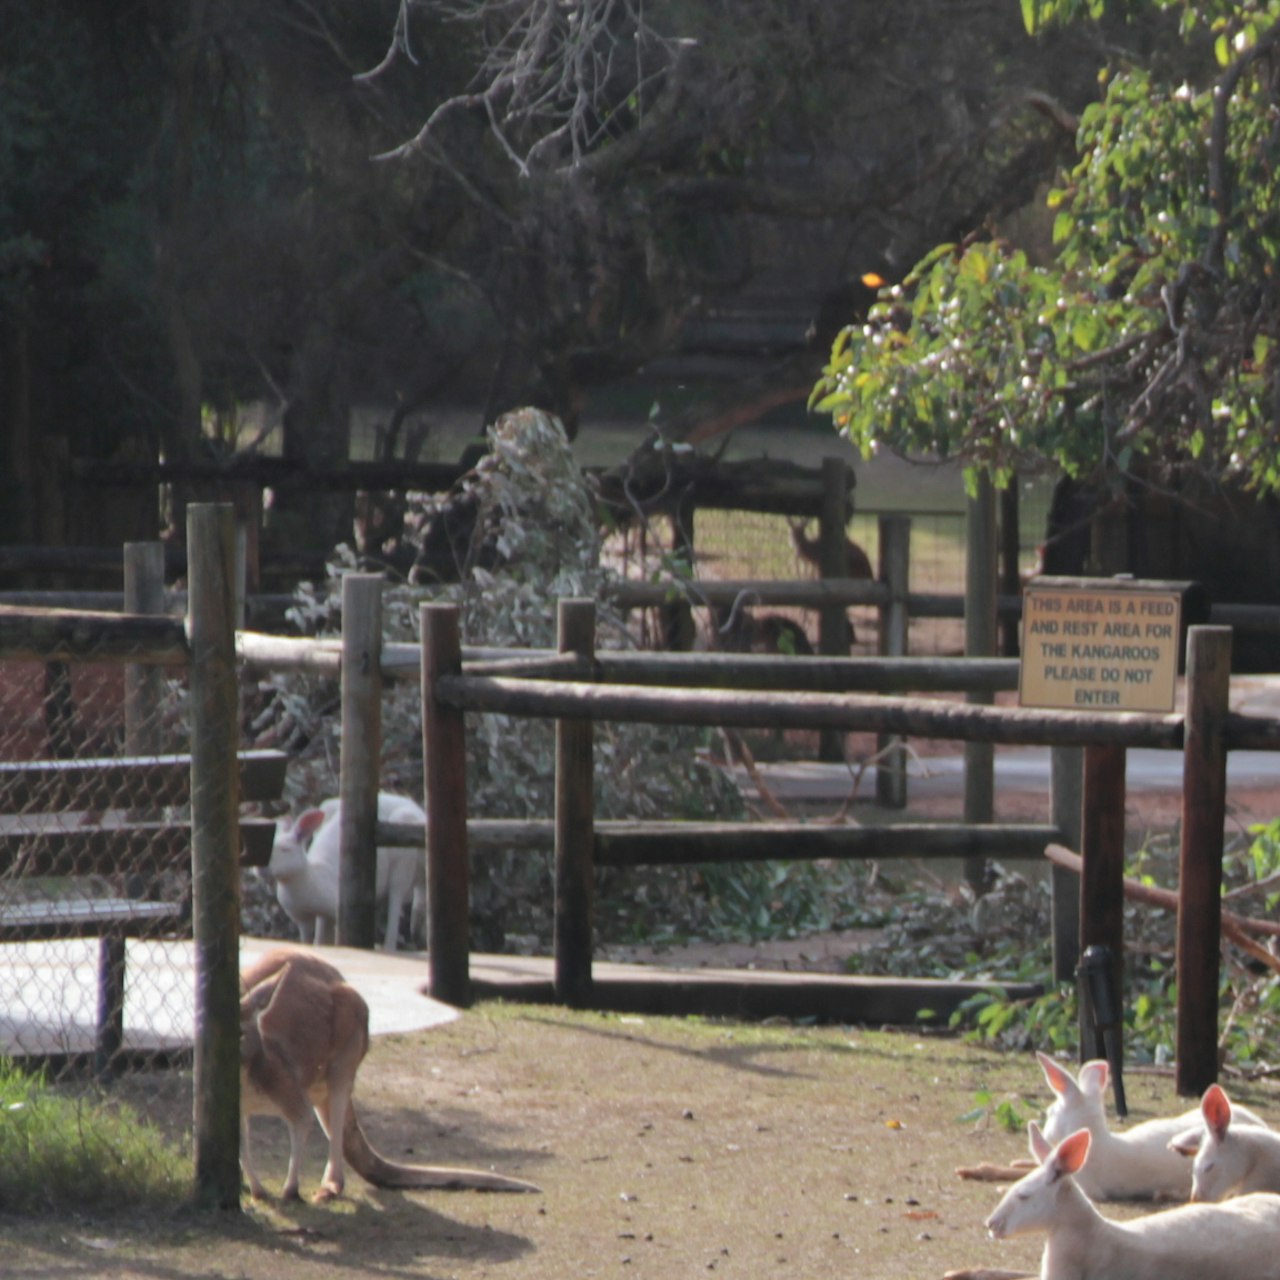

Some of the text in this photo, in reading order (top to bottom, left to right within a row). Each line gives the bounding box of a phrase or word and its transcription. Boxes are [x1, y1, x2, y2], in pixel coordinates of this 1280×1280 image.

[1032, 598, 1174, 615] THIS AREA IS A FEED
[1031, 620, 1172, 638] AND REST AREA FOR
[1041, 643, 1160, 661] THE KANGAROOS
[1044, 667, 1153, 683] PLEASE DO NOT
[1075, 689, 1119, 704] ENTER
